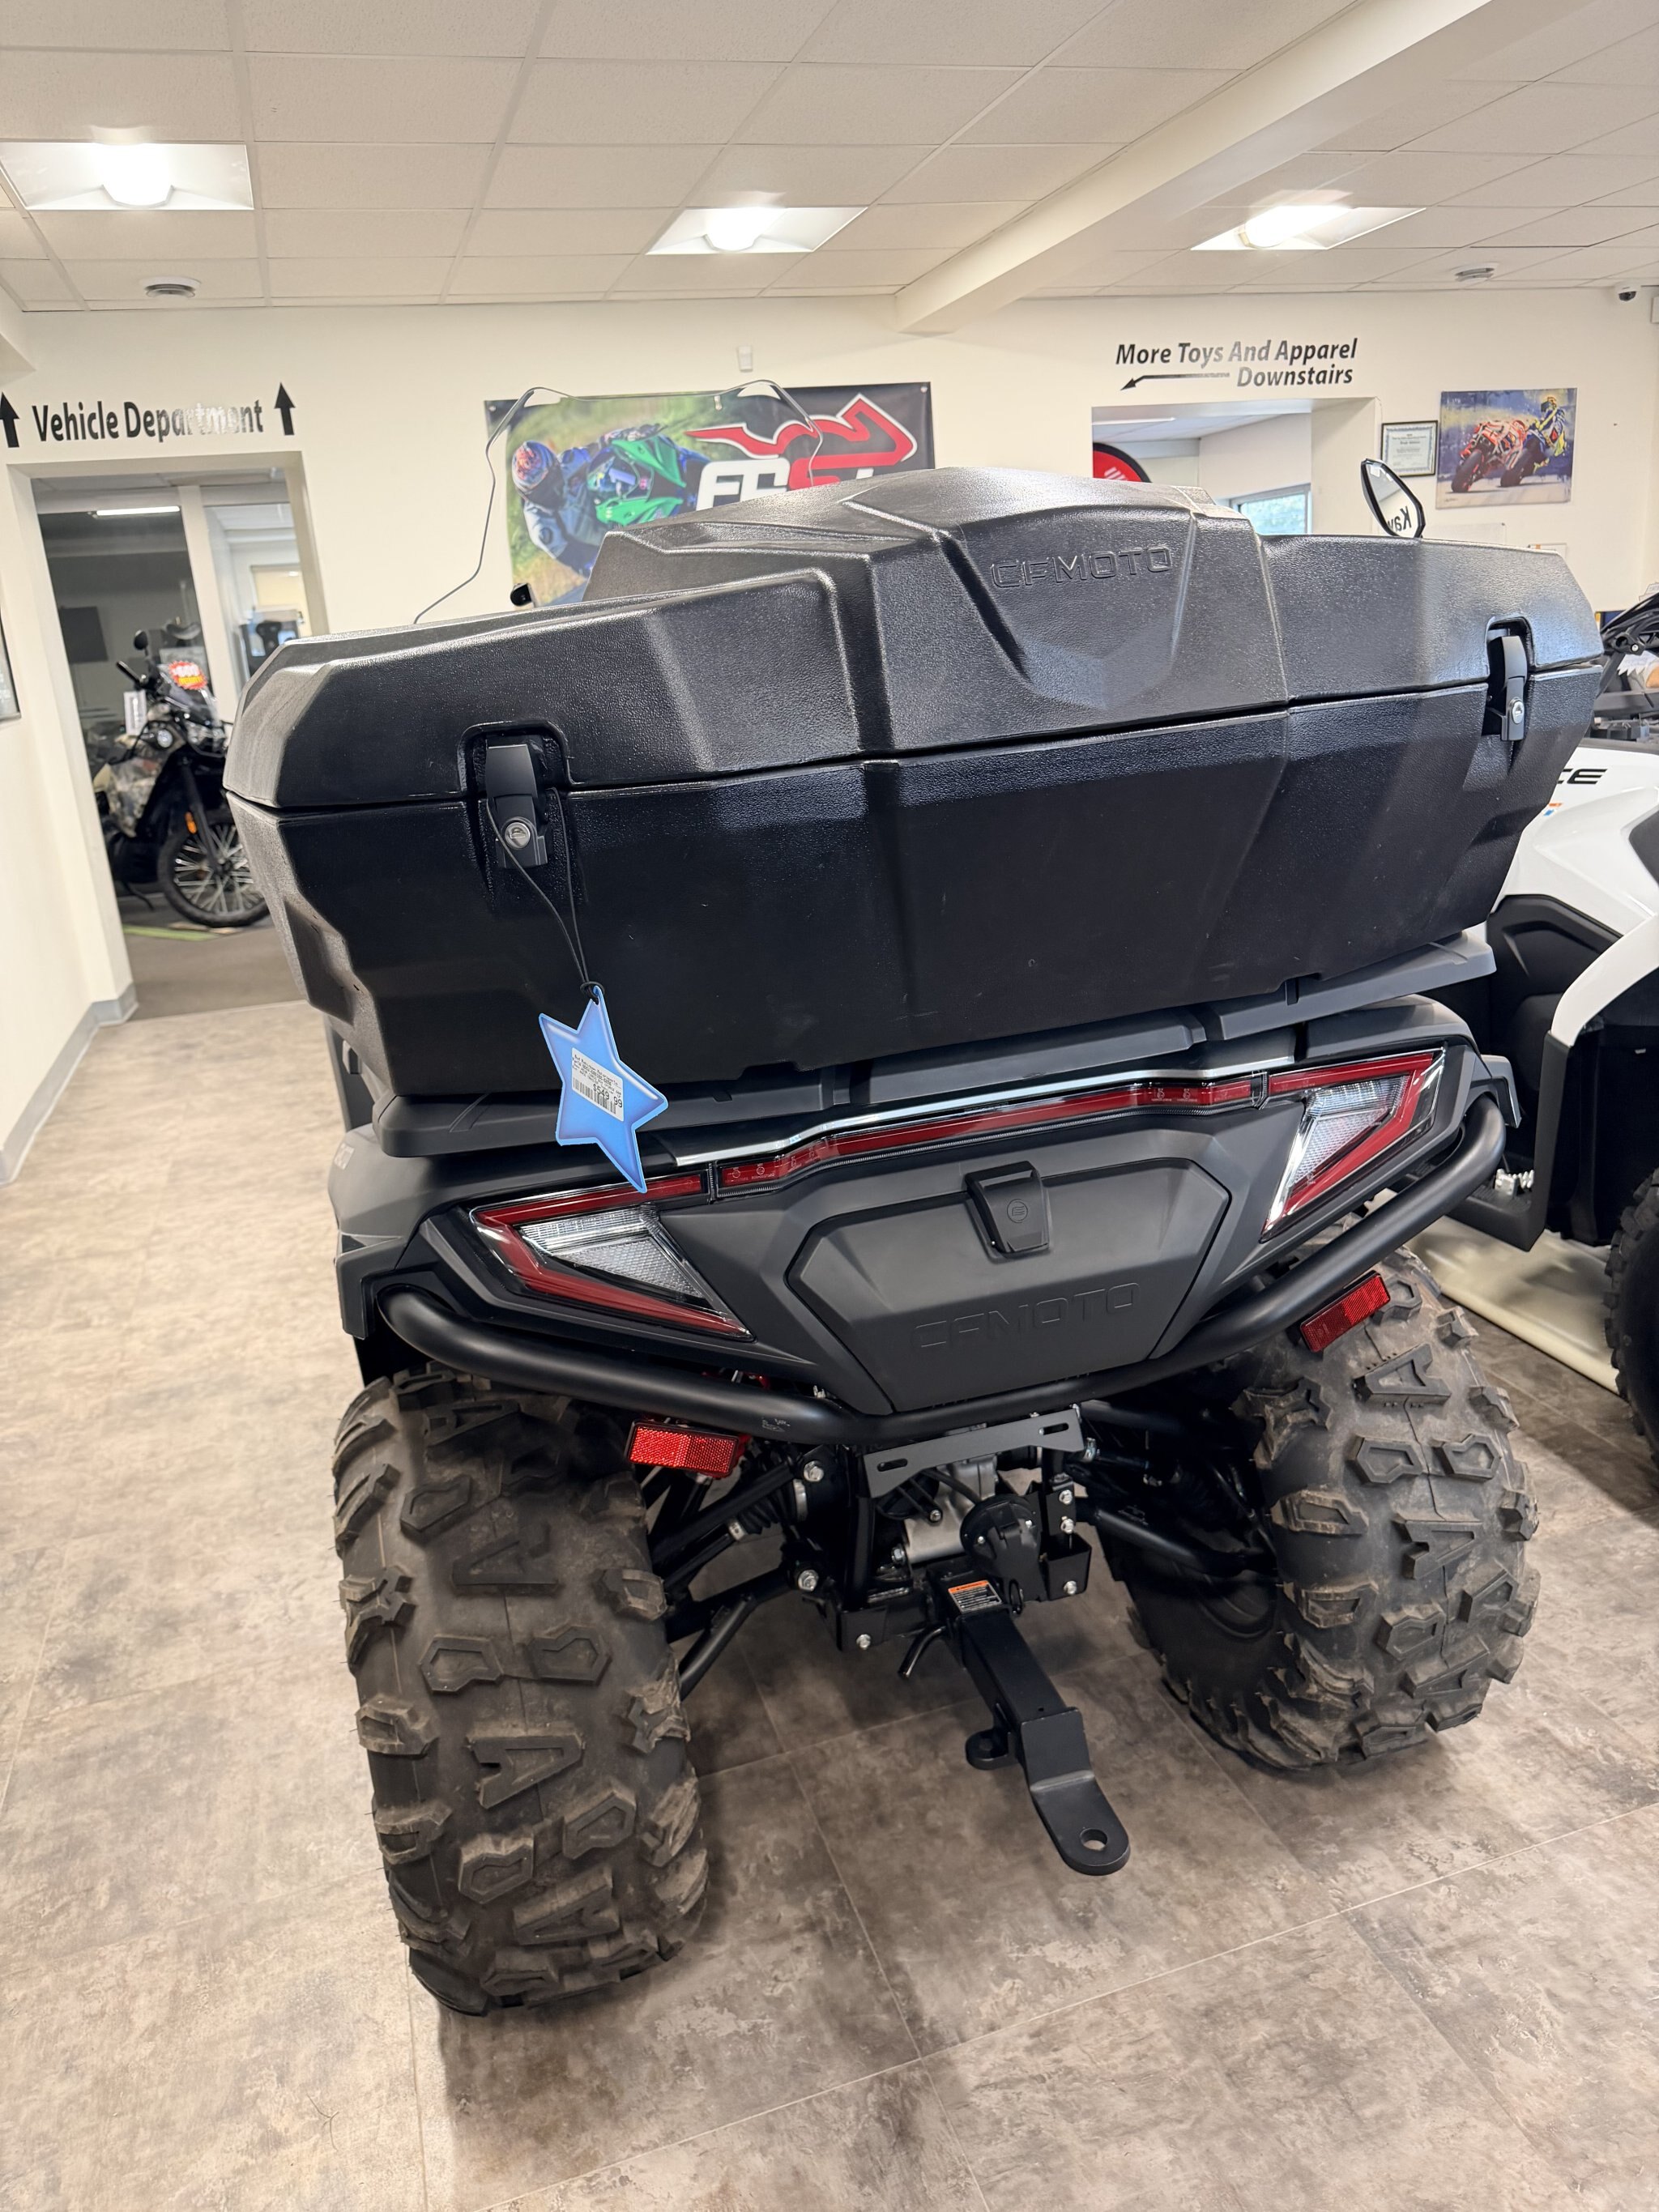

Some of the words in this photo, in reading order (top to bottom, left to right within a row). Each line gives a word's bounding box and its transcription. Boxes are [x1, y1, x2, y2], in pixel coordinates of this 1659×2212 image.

[1115, 343, 1171, 364] More
[1178, 343, 1224, 369] Toys
[1228, 339, 1272, 362] And
[1274, 338, 1358, 365] Apparel
[1237, 364, 1354, 387] Downstairs
[32, 401, 120, 441] Vehicle
[124, 399, 263, 443] Department
[991, 544, 1173, 589] CFMOTO
[914, 1281, 1141, 1349] CFMOTO
